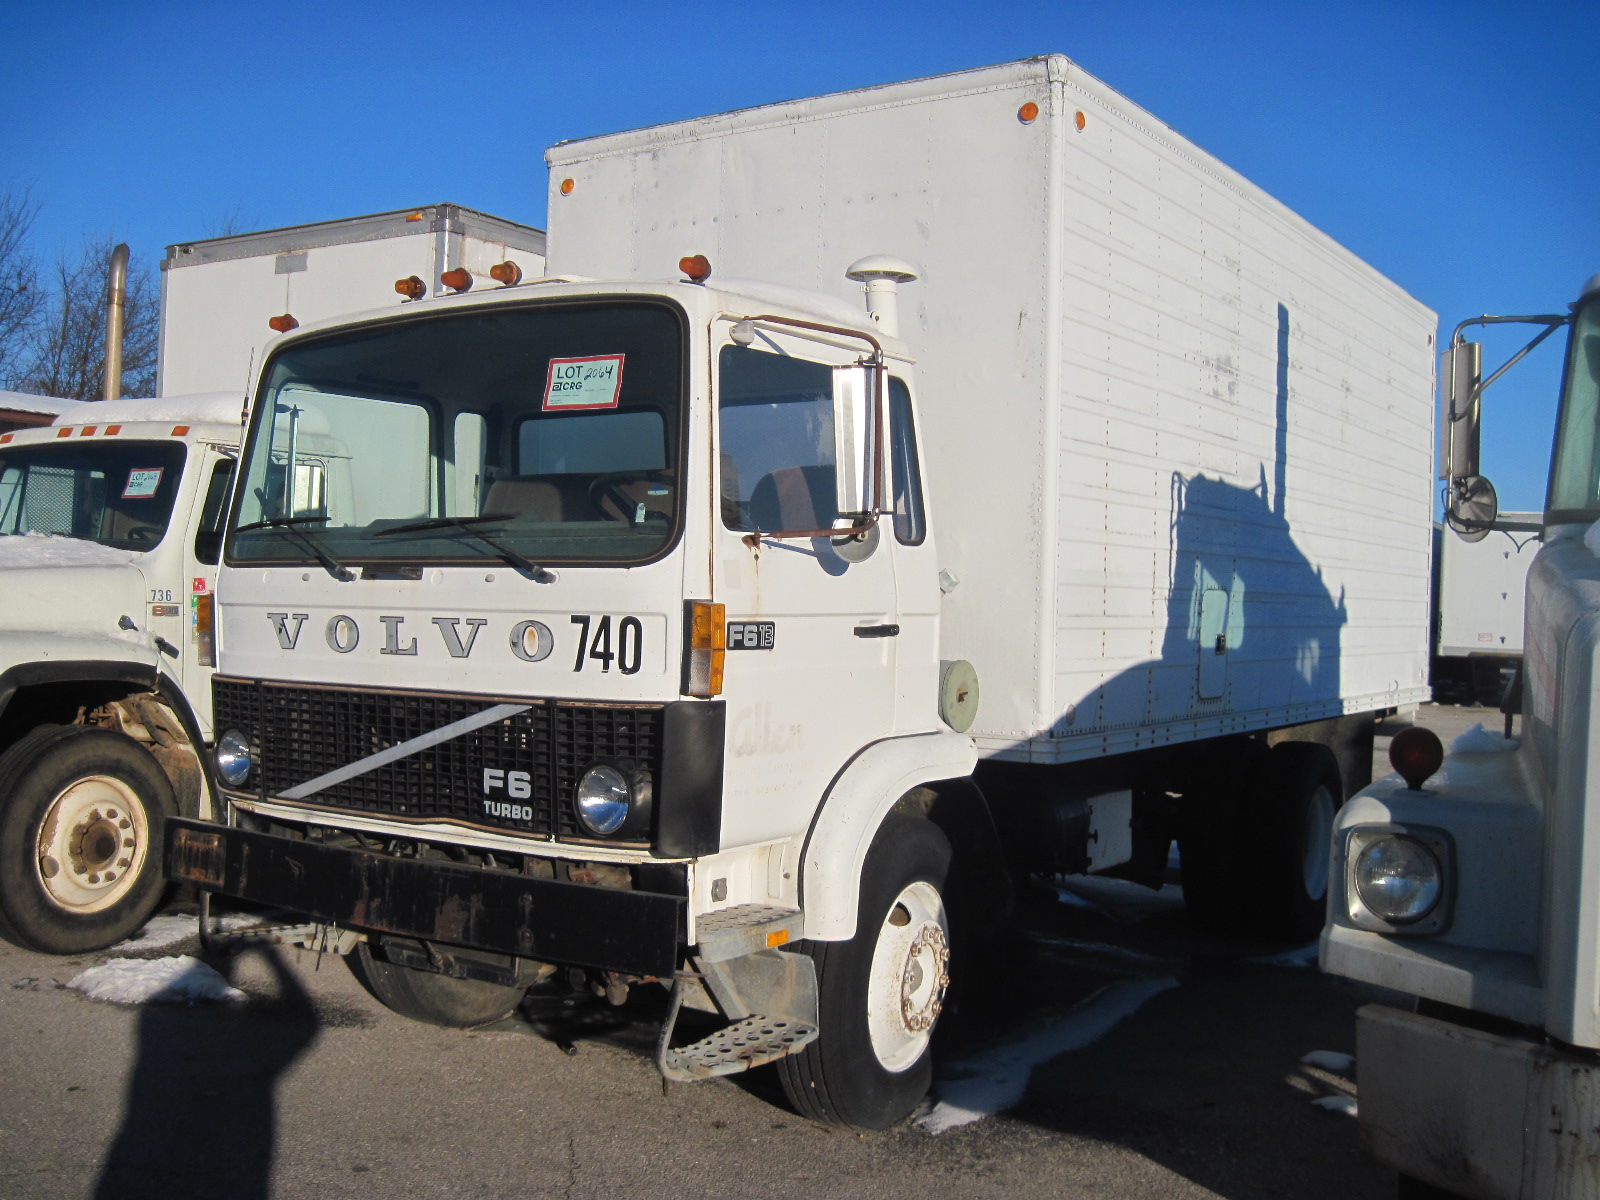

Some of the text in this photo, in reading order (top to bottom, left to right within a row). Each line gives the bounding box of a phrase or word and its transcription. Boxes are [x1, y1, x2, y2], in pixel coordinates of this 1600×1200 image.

[557, 364, 614, 381] LOT 2064
[562, 381, 583, 391] CRG
[132, 472, 145, 481] LOT
[150, 589, 172, 602] 736
[267, 612, 643, 676] VOLVO 740
[483, 767, 532, 799] F6
[483, 799, 533, 821] TURBO
